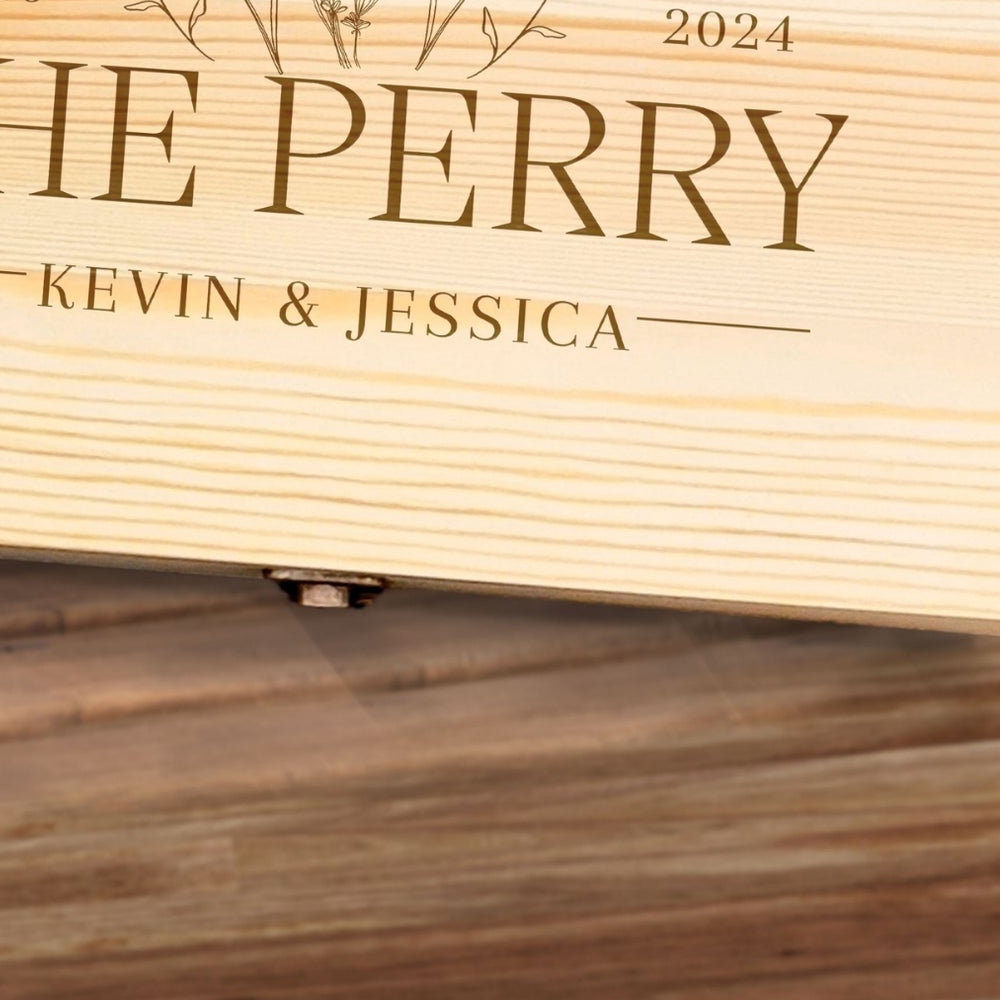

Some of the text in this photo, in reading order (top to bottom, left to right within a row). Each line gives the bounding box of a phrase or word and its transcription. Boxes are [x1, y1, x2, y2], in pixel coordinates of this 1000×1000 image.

[662, 8, 795, 52] 2024
[255, 75, 849, 252] PERRY
[37, 262, 632, 352] KEVIN & JESSICA
